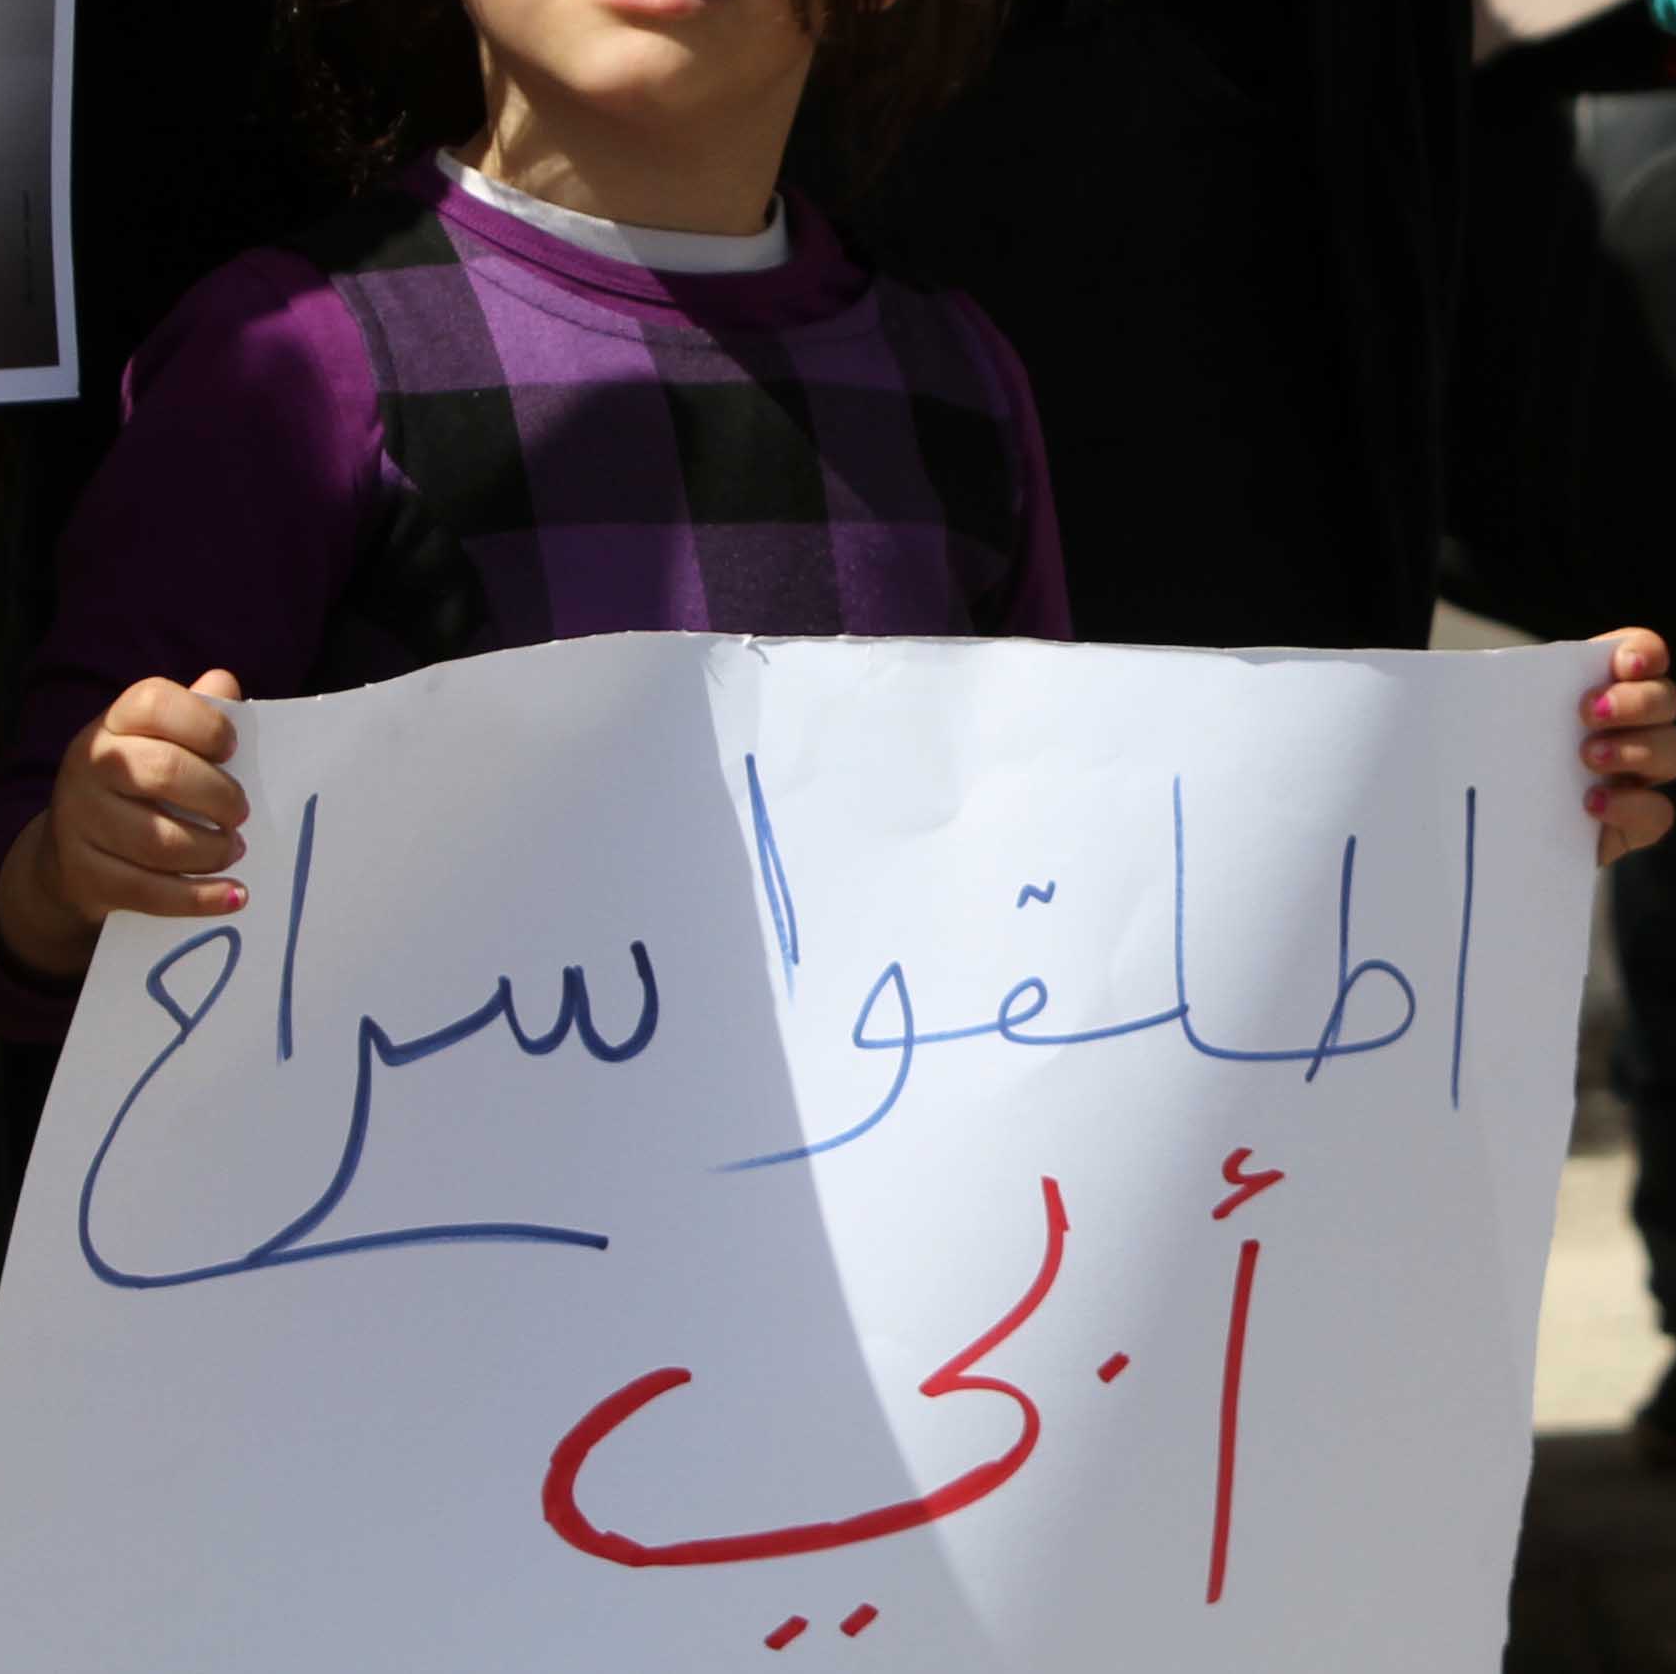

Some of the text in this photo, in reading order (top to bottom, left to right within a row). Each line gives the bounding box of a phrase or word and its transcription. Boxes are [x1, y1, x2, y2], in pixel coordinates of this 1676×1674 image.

[79, 754, 1478, 1291] اطلقوا سراح
[540, 1147, 1284, 1649] أبي
